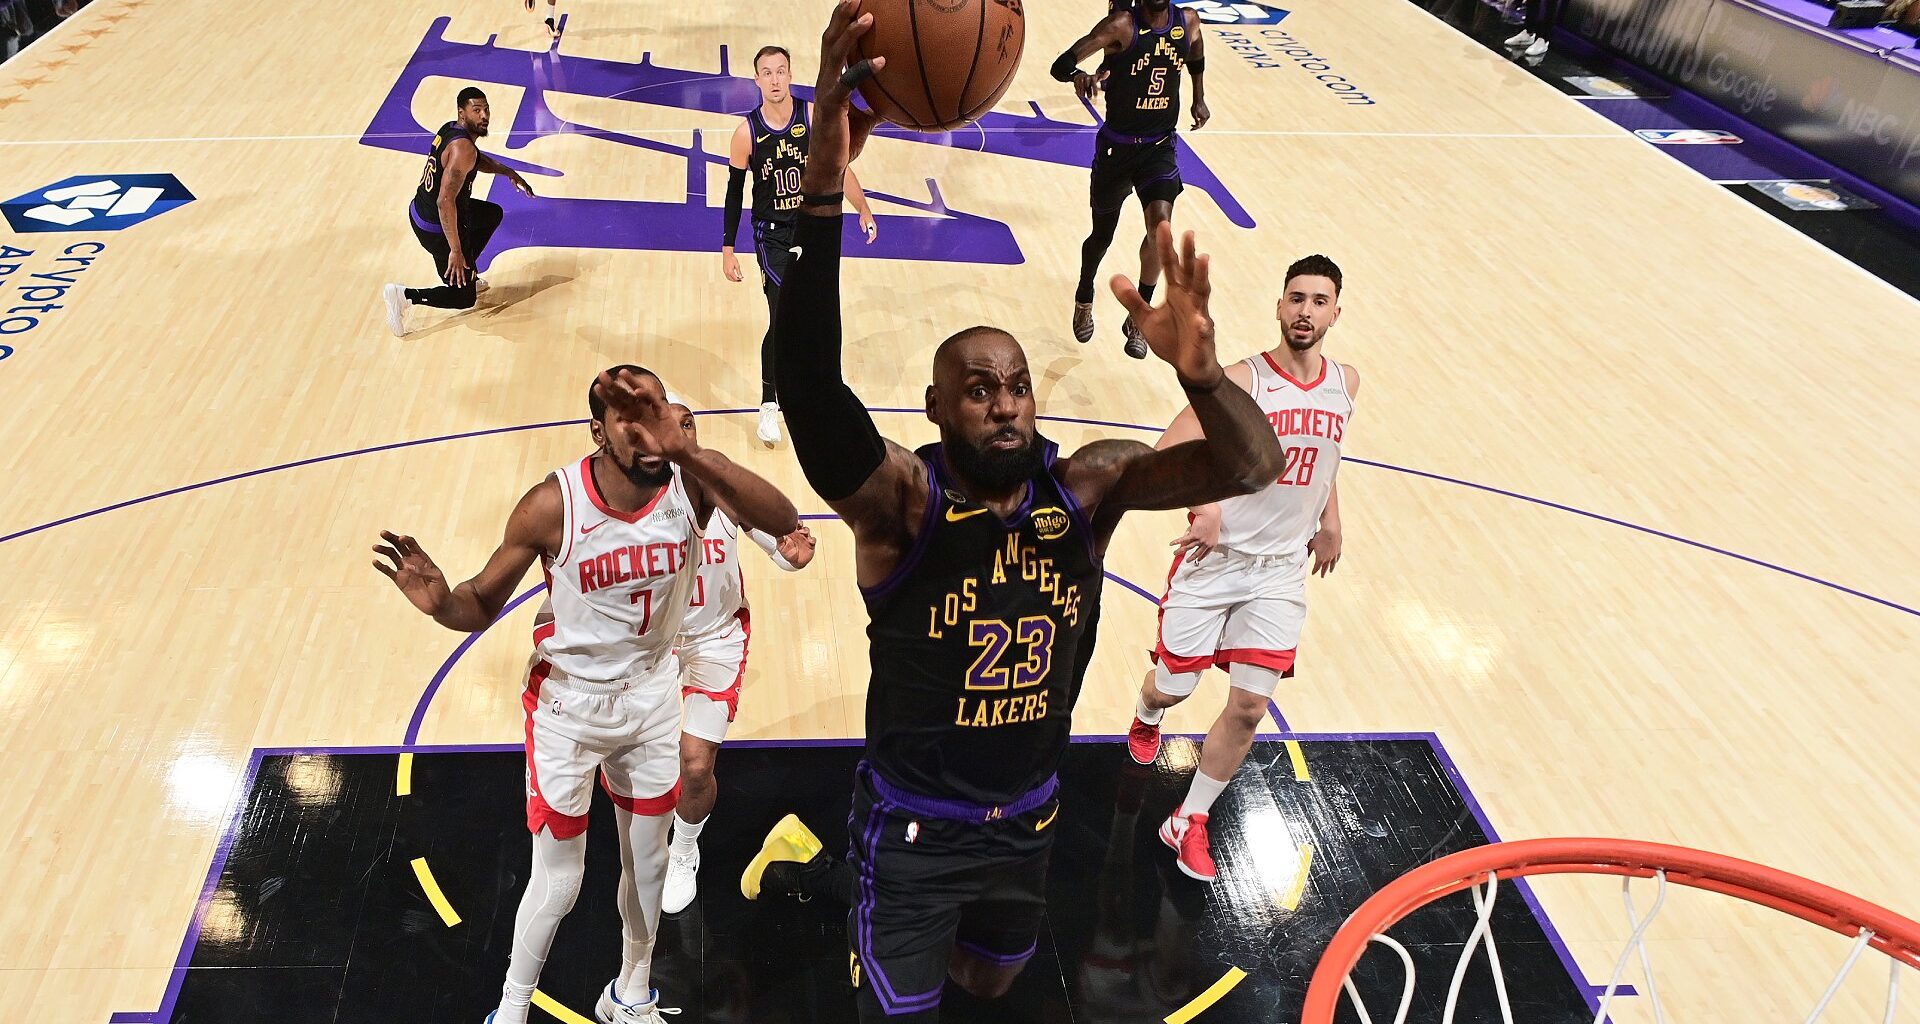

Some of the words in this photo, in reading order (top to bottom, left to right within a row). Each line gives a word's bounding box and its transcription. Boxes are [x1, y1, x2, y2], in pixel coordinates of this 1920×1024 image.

[1130, 53, 1151, 76] LOS
[1154, 36, 1184, 71] ANGELE
[1211, 29, 1282, 69] ARENA
[1259, 29, 1376, 105] crypto.com
[1147, 67, 1168, 95] 5
[1706, 51, 1778, 114] Google
[1135, 97, 1170, 110] LAKERS
[1837, 98, 1900, 146] NBC
[420, 152, 437, 193] 6
[761, 158, 774, 181] LOS
[776, 138, 809, 168] ANGELE
[774, 166, 801, 197] 10
[773, 195, 804, 211] LAKER
[0, 241, 106, 361] crypto
[1276, 446, 1319, 486] 28
[578, 539, 688, 594] ROCKETS
[928, 576, 977, 639] LOS
[991, 532, 1081, 627] ANGELES
[629, 589, 653, 637] 7
[964, 614, 1057, 691] 23
[955, 690, 1049, 728] LAKERS
[984, 806, 1003, 821] LAL
